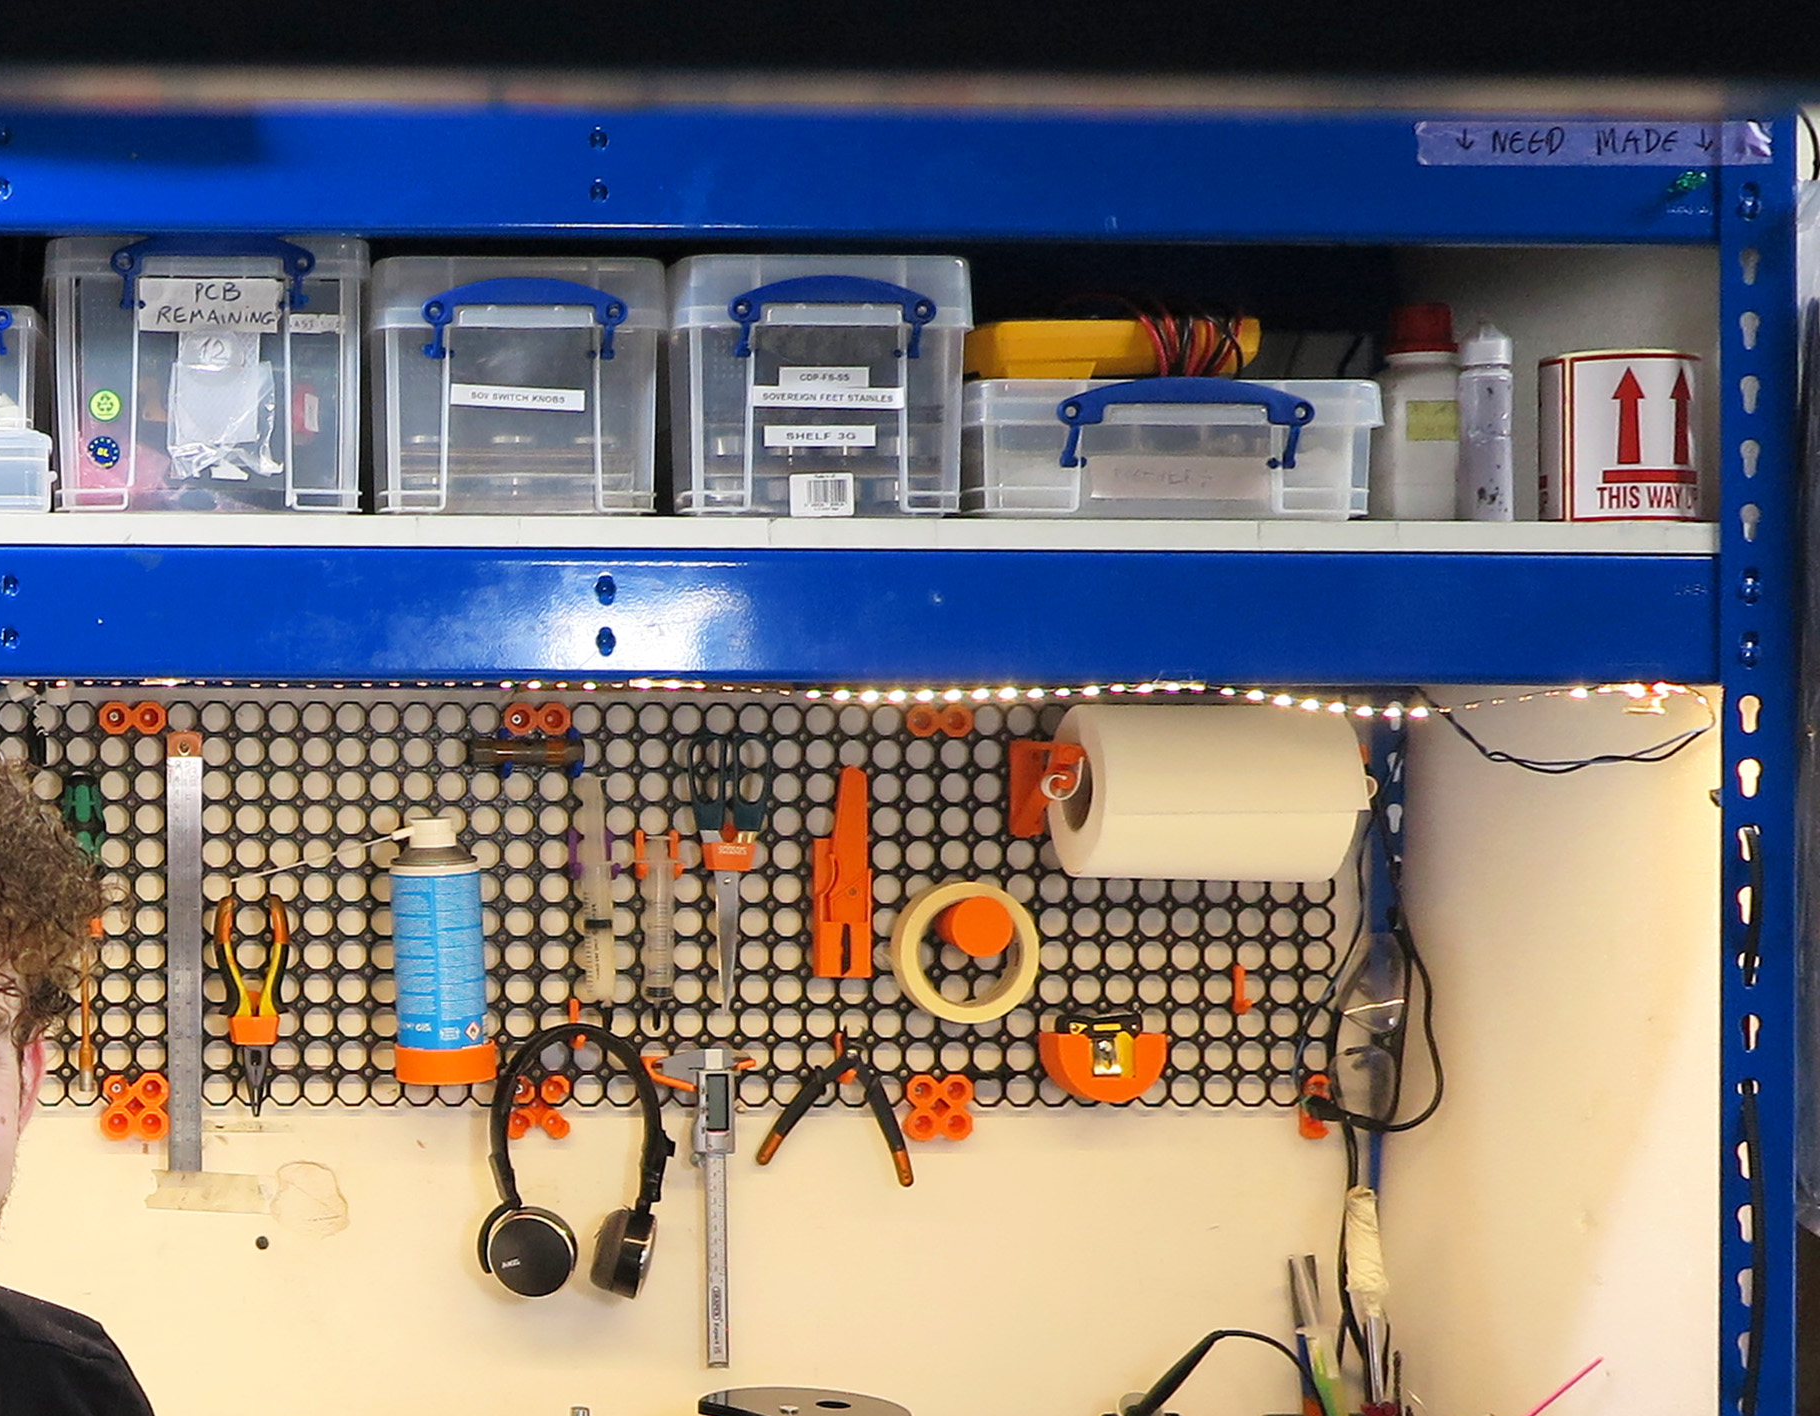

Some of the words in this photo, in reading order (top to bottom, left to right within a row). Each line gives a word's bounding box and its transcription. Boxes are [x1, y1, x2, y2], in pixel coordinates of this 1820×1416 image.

[1491, 125, 1566, 155] NEED
[1596, 126, 1679, 155] MADE
[194, 282, 242, 303] PCB
[156, 305, 276, 326] REMAINING
[492, 392, 529, 402] SWITCH
[762, 392, 817, 402] SOVEREIGN
[786, 432, 832, 441] SHELF
[1596, 485, 1641, 510] THIS
[1647, 485, 1681, 509] WAY
